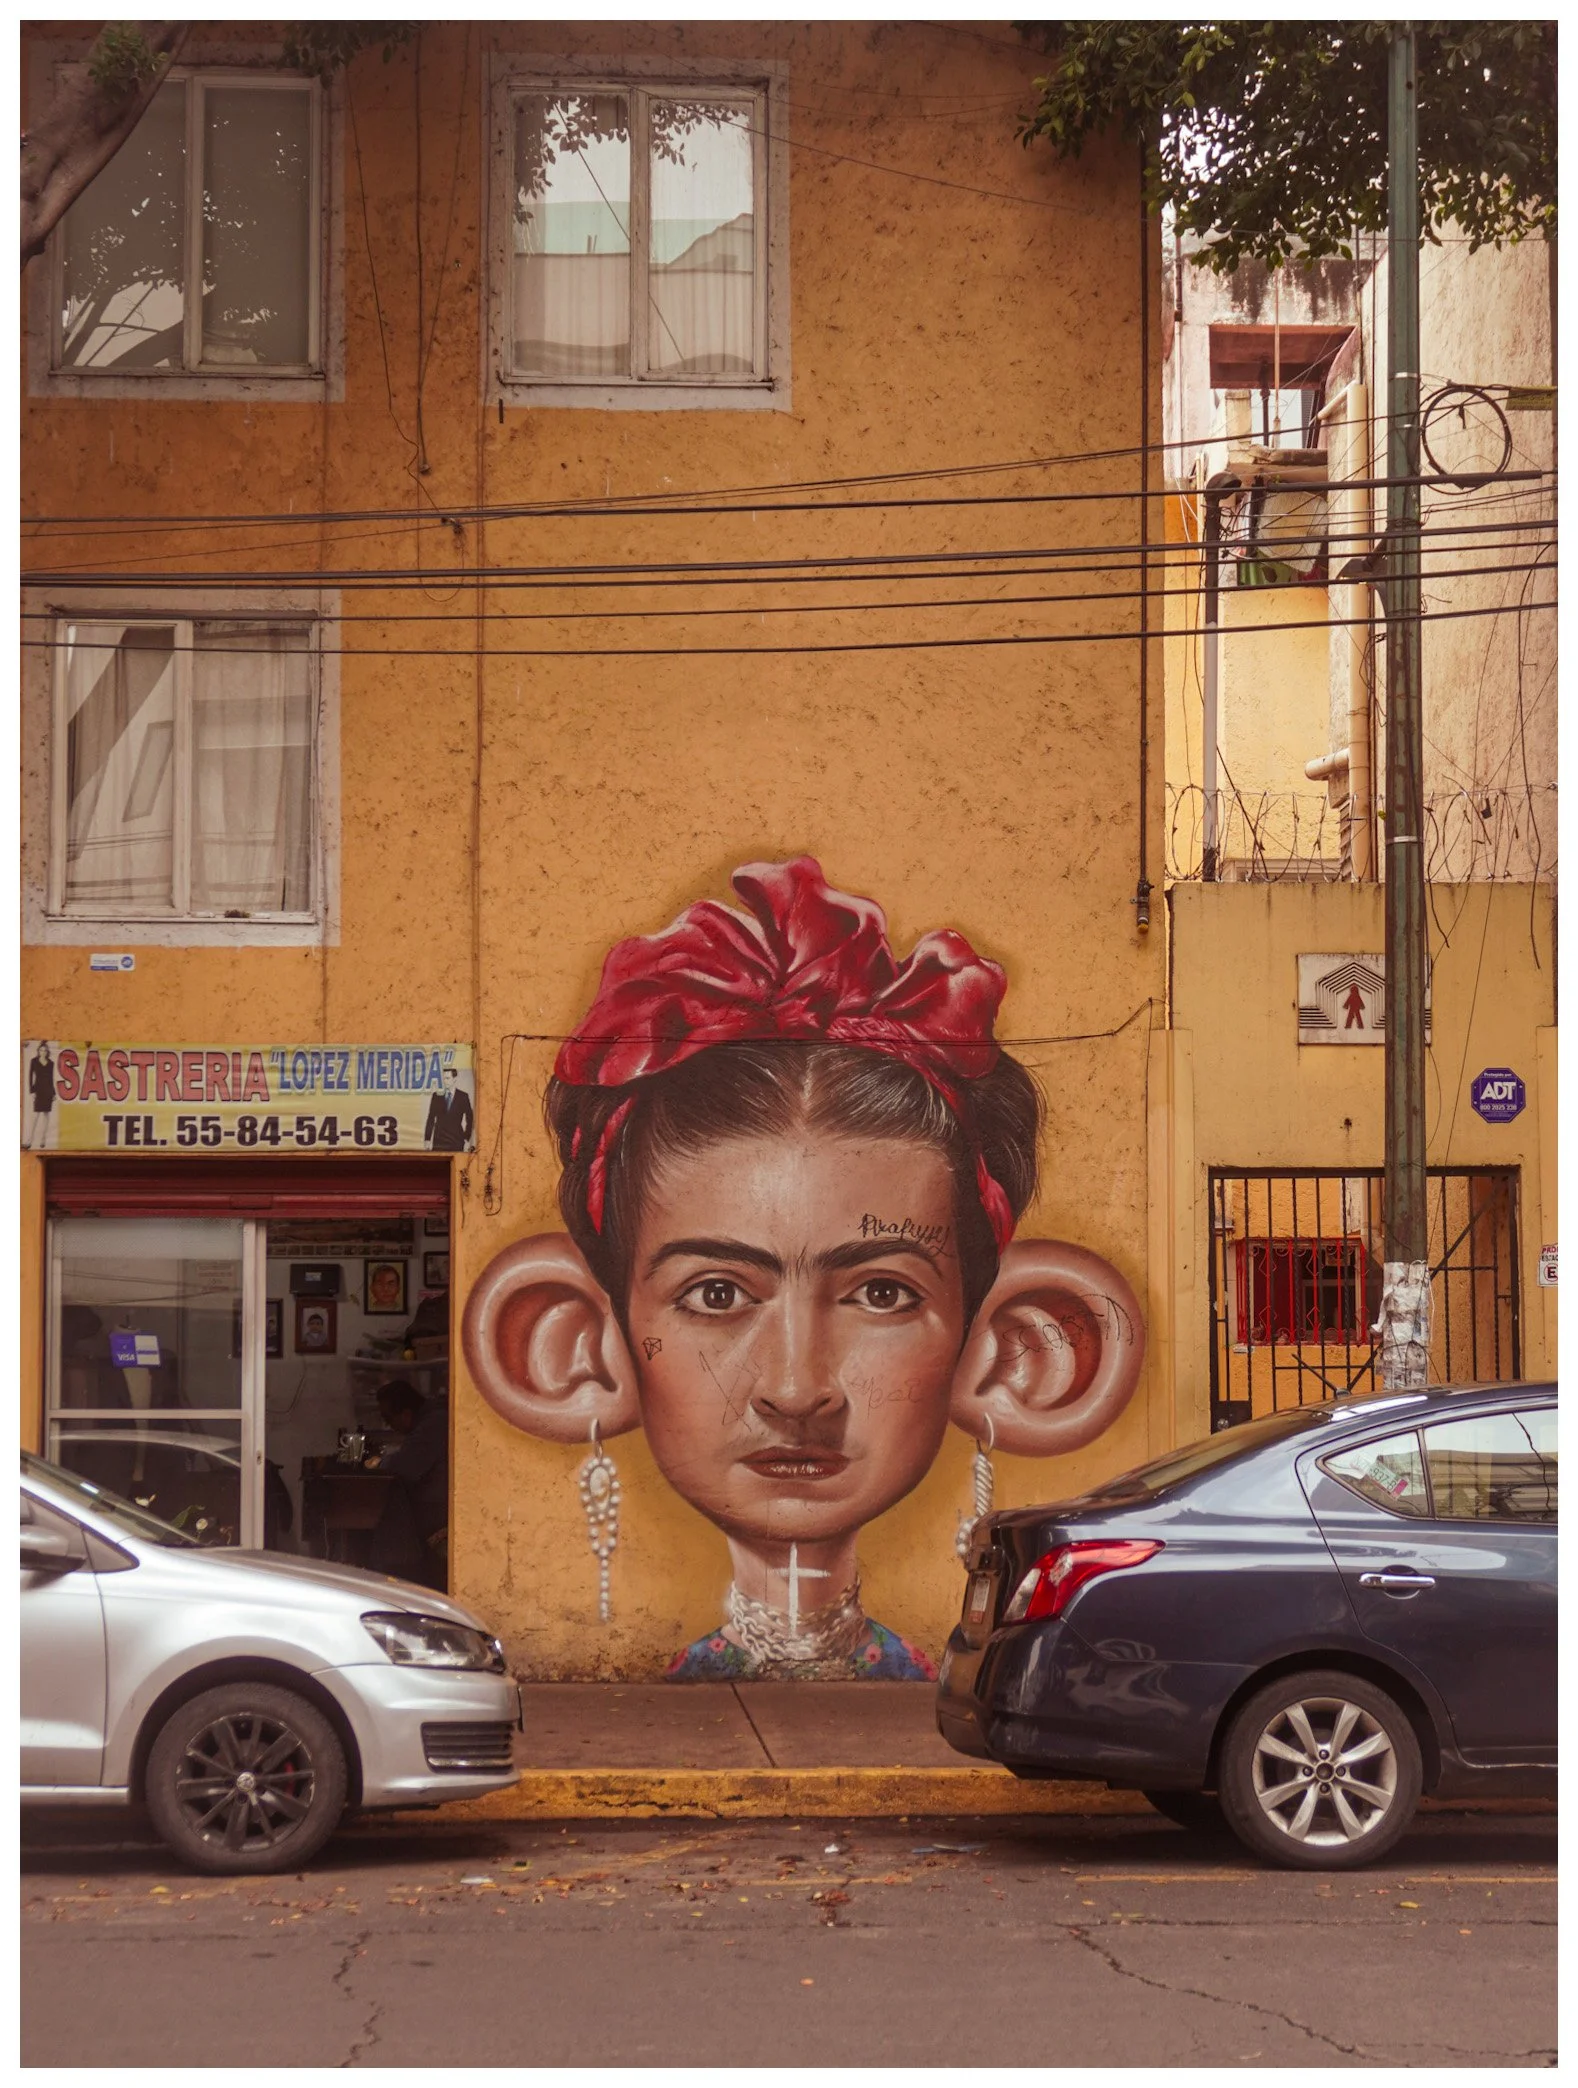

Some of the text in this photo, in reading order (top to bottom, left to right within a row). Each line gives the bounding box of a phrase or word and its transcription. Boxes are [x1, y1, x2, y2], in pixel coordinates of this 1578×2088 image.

[56, 1048, 270, 1102] SASTRERIA
[1480, 1081, 1517, 1100] ADT
[103, 1115, 398, 1147] TEL. 55-84-54-63
[1541, 1246, 1558, 1254] PRO
[117, 1353, 135, 1361] VISA
